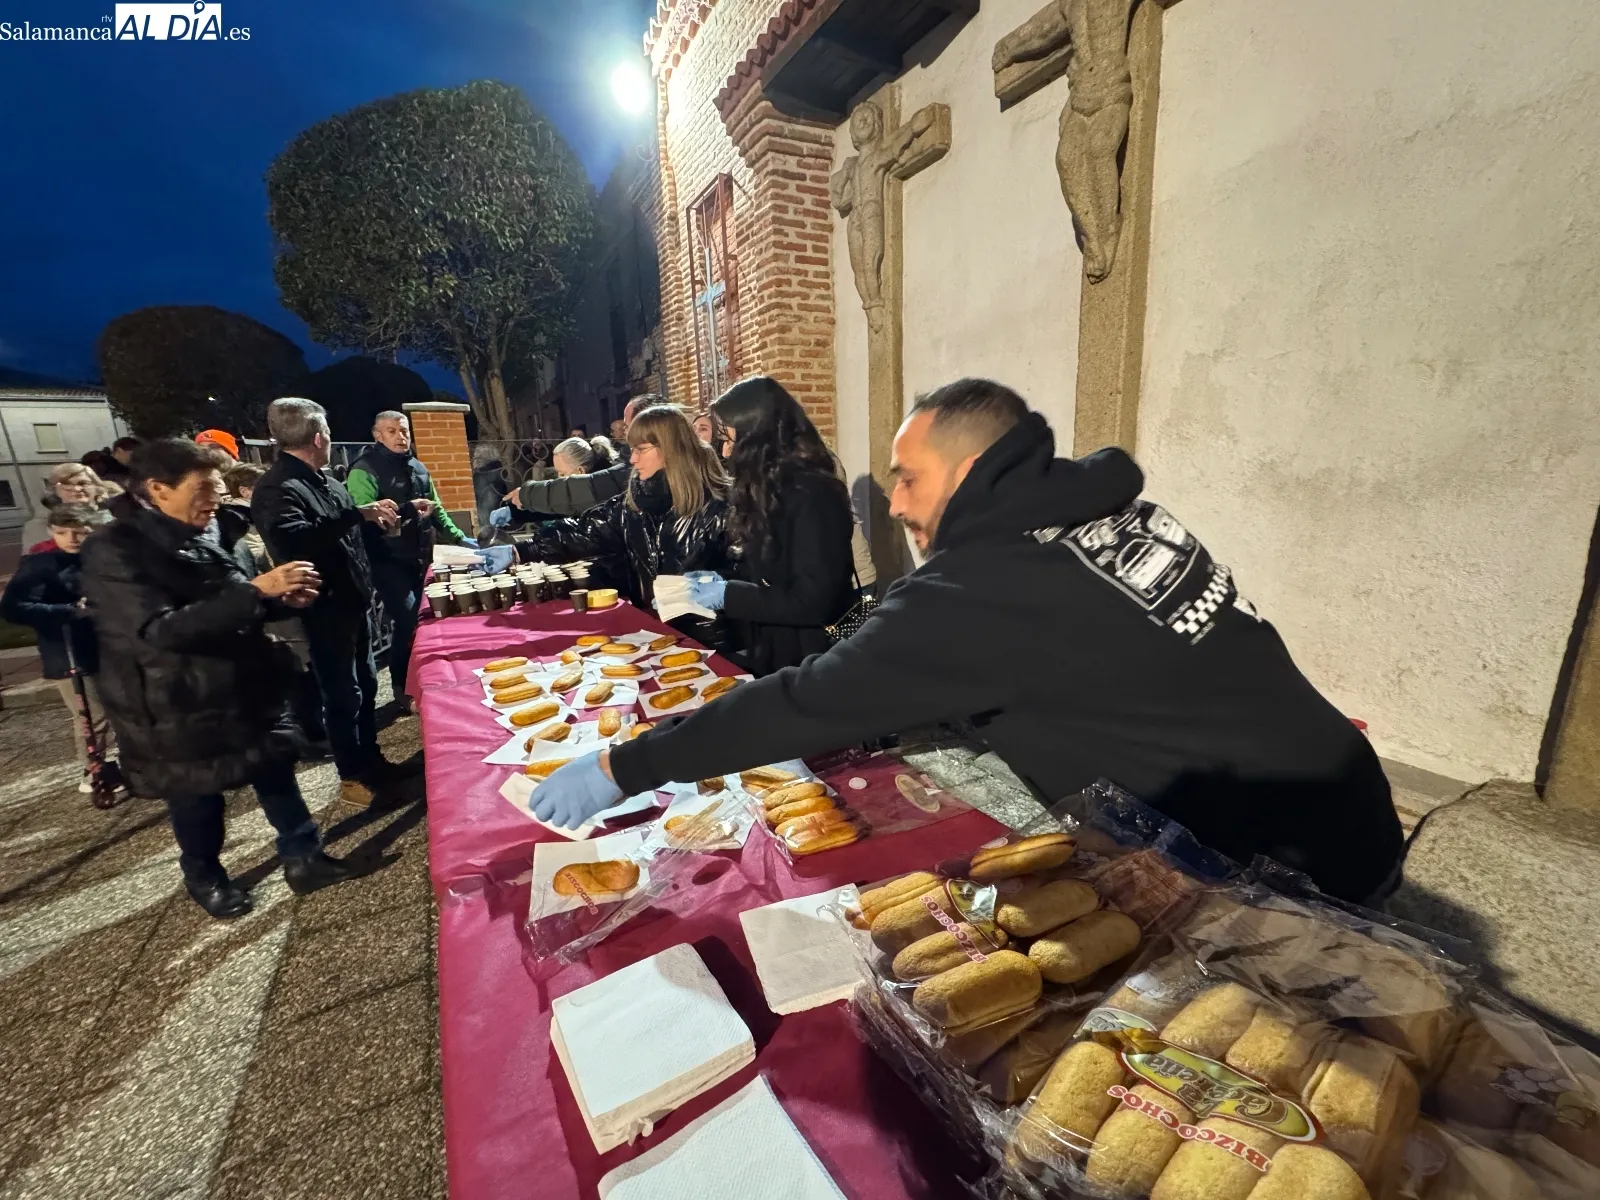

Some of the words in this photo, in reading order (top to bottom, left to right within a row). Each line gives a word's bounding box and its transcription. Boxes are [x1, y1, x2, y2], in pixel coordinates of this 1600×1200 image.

[920, 896, 988, 963] BIZCOCHOS
[1107, 1085, 1272, 1172] BIZCOCHOS
[1177, 1083, 1225, 1118] La
